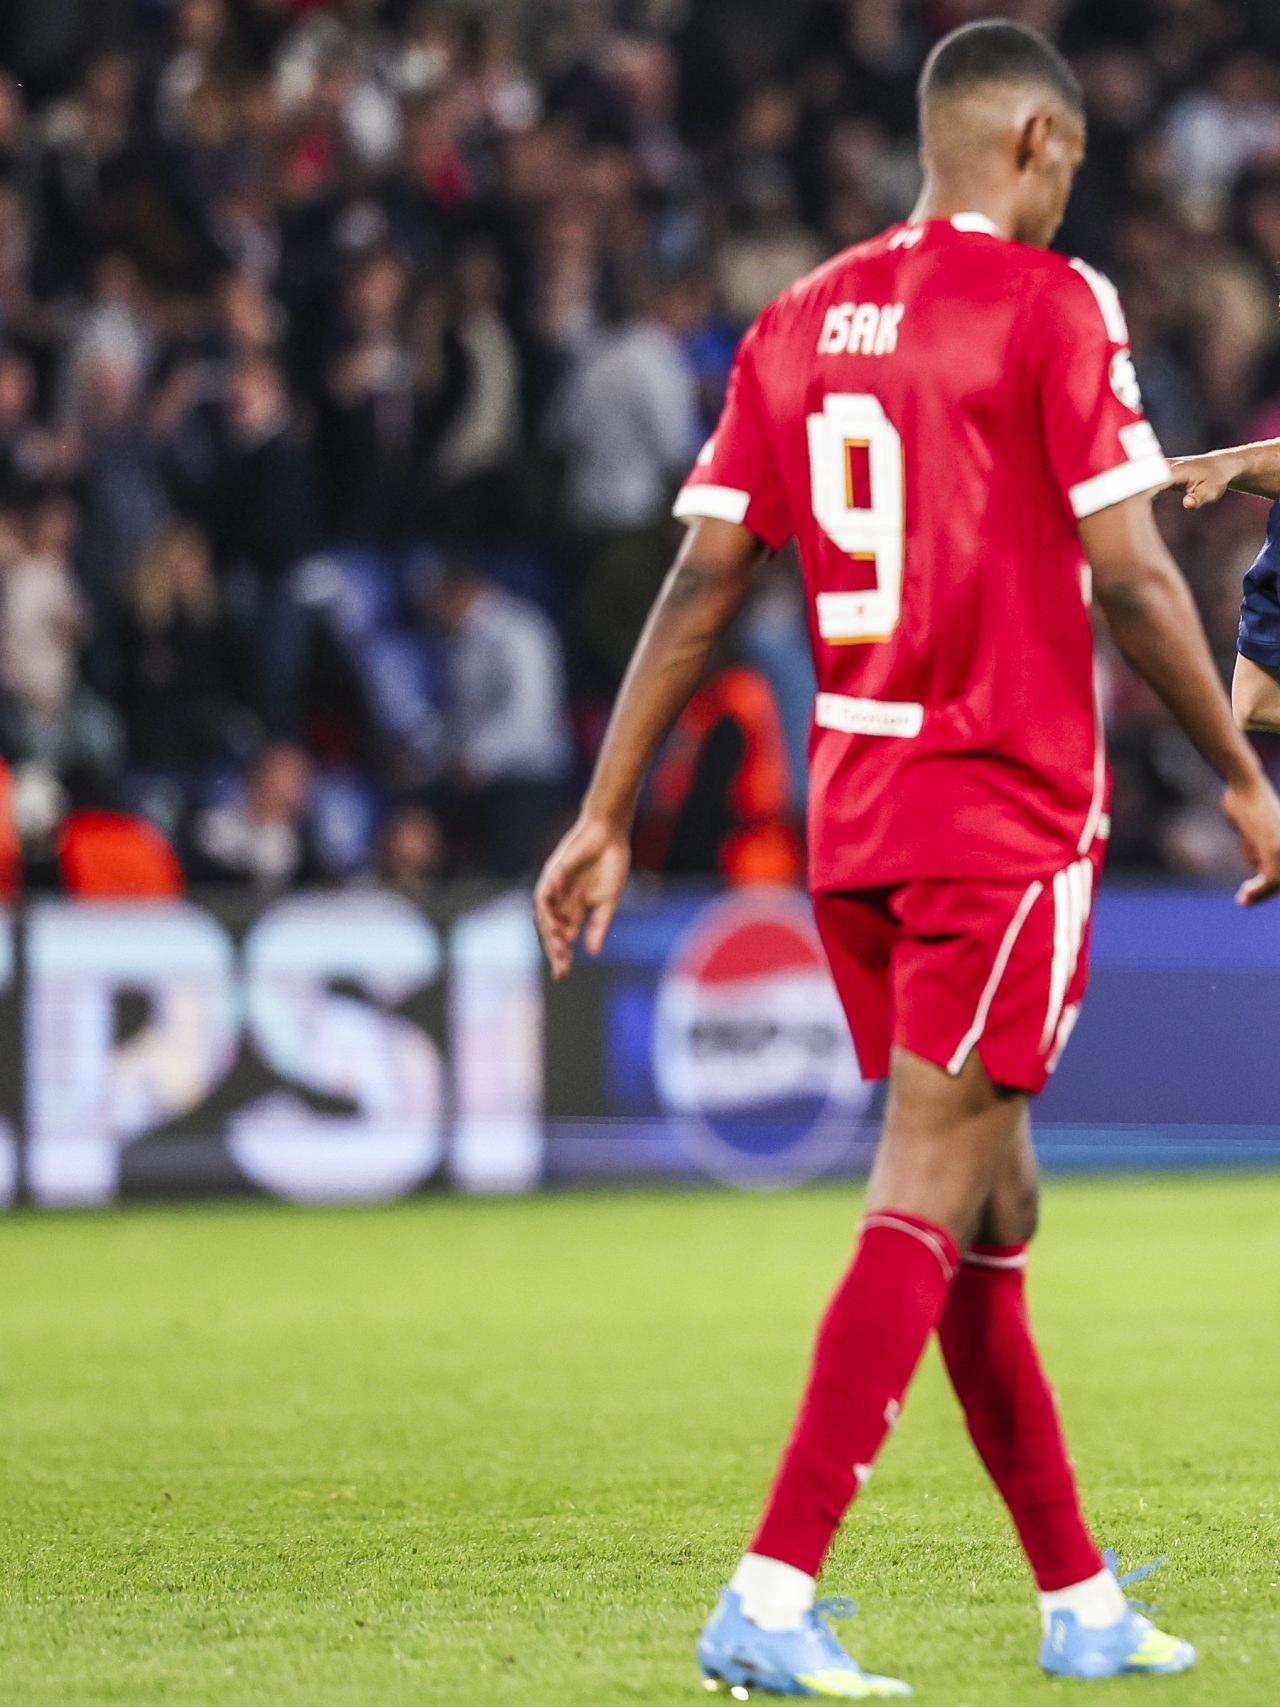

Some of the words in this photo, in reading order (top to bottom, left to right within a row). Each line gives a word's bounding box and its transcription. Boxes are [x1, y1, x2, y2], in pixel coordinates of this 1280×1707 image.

[816, 302, 905, 356] ISAK
[806, 393, 905, 645] 9
[0, 891, 545, 1206] PSI
